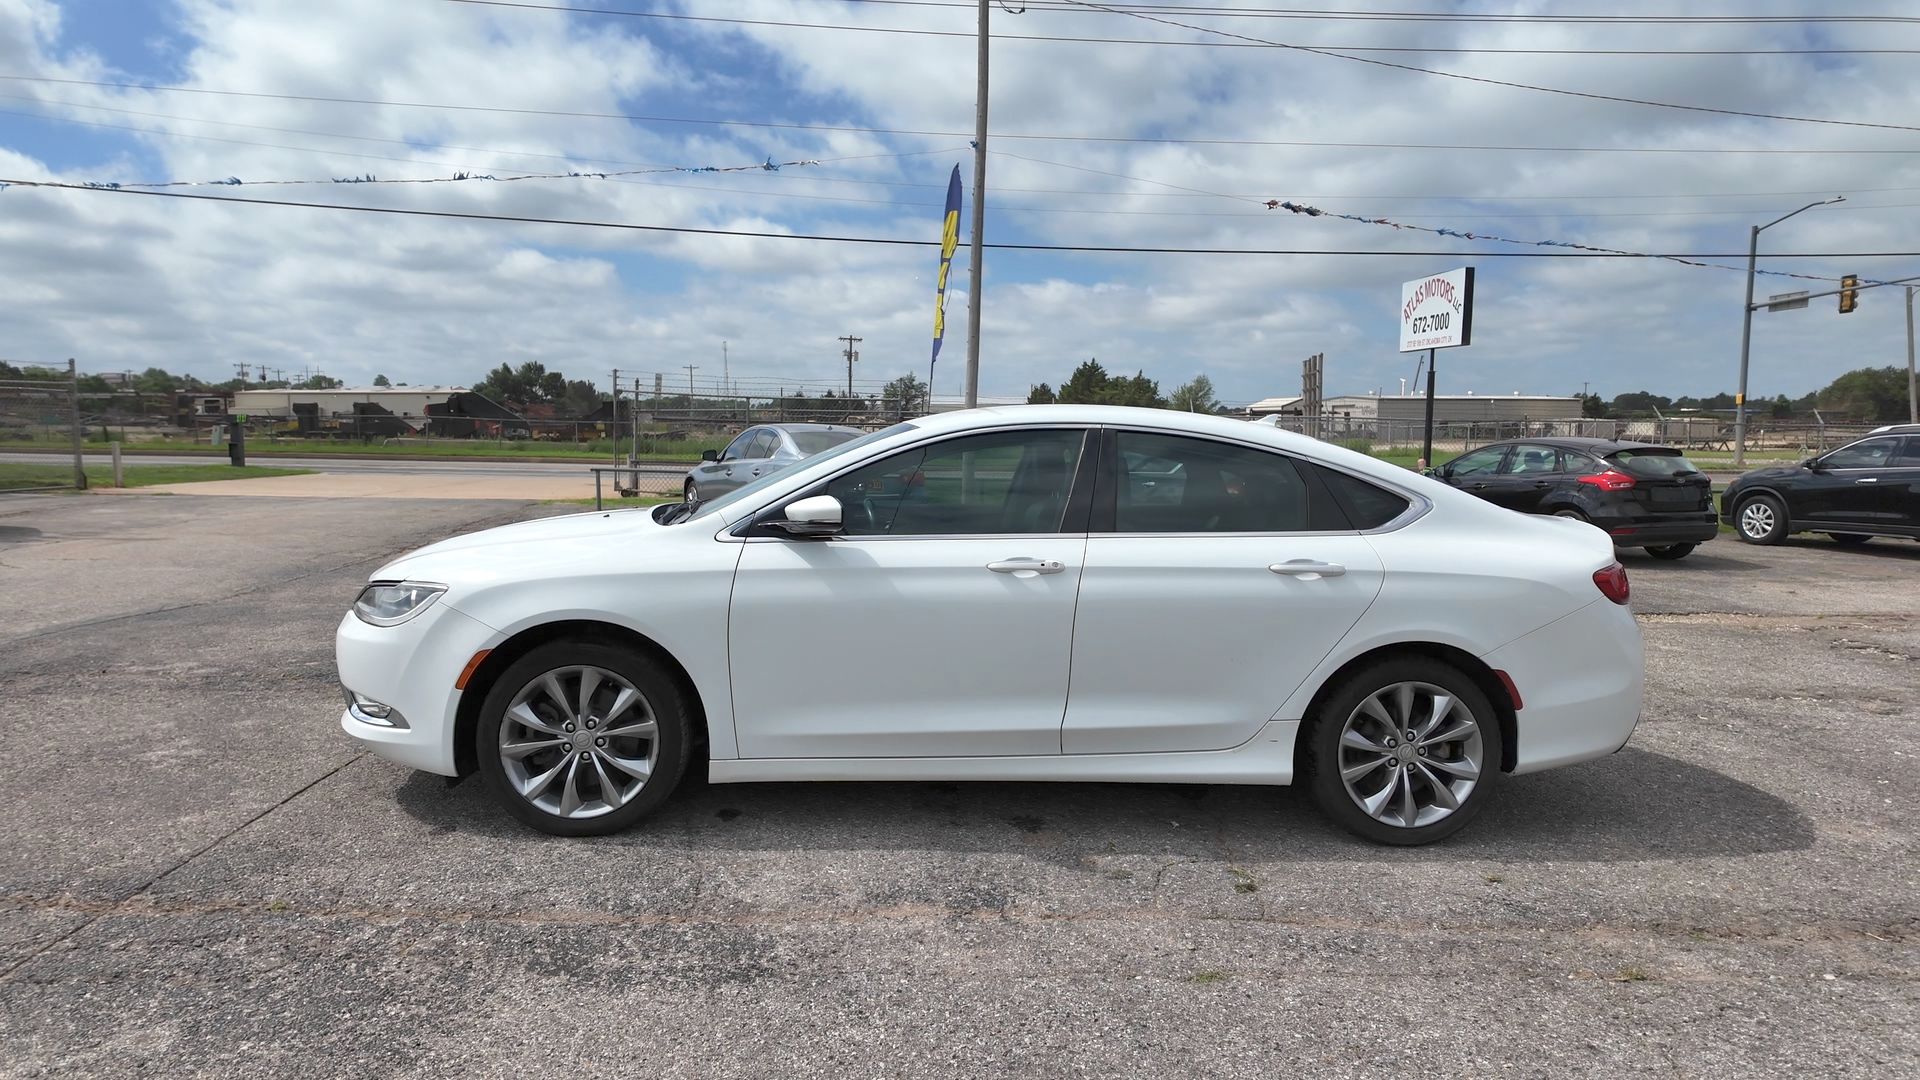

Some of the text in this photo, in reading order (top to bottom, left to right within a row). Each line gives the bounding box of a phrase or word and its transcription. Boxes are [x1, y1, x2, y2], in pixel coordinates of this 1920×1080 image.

[1403, 278, 1462, 324] ATLAS MOTORS LLC
[1412, 312, 1450, 334] 672-7000
